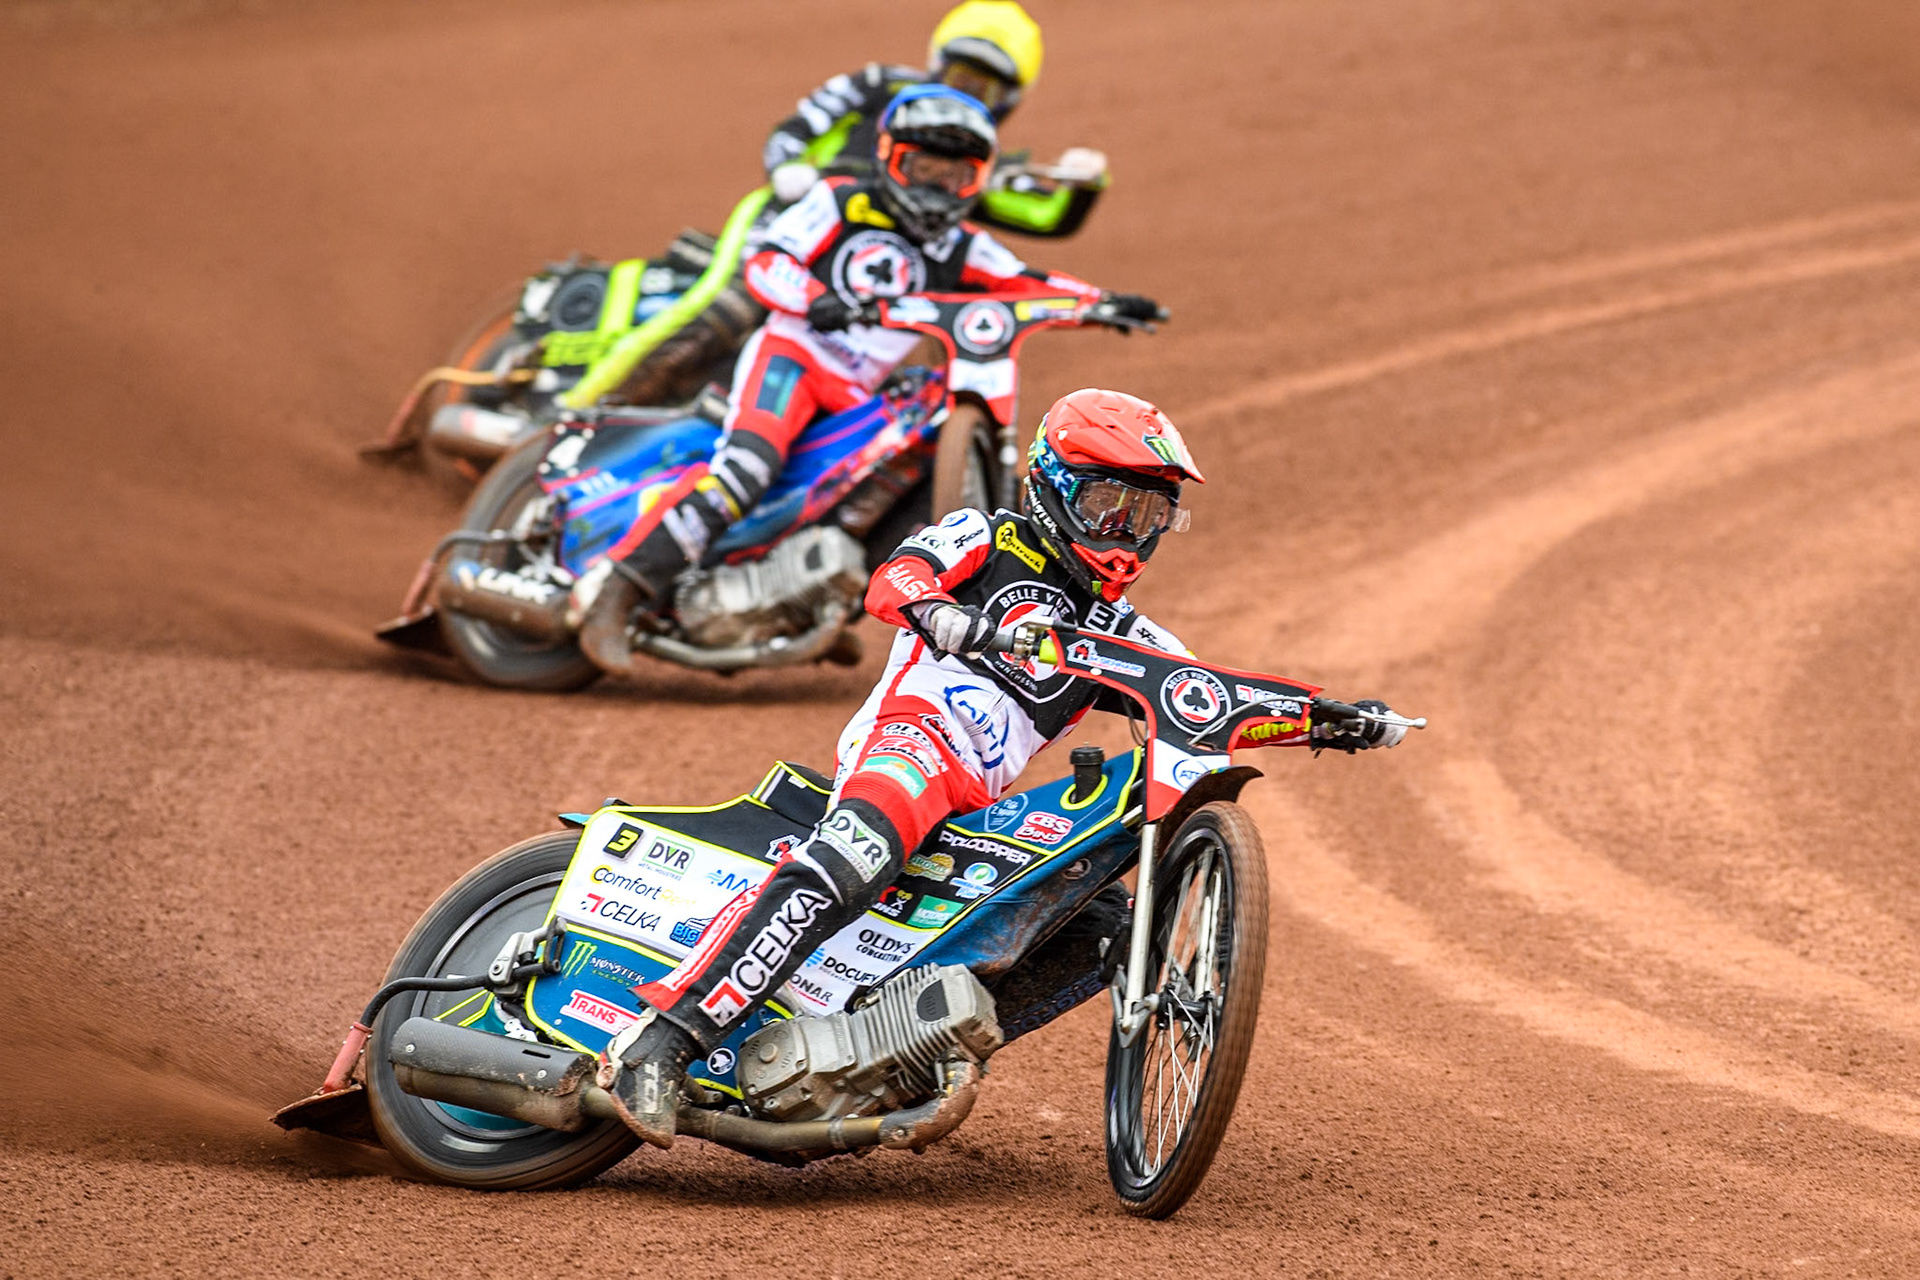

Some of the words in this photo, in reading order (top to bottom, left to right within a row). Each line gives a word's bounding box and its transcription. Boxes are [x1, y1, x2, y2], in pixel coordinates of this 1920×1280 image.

[998, 588, 1039, 609] BELLE
[1045, 592, 1070, 618] VUE
[1166, 672, 1190, 690] BELLE
[1190, 672, 1210, 682] VUE
[1017, 826, 1060, 841] BINS
[1027, 813, 1069, 834] CBS
[608, 829, 639, 853] 3
[829, 816, 883, 867] DVR
[648, 841, 690, 870] DVR
[592, 867, 662, 900] Comfort
[600, 900, 662, 932] CELKA
[673, 923, 699, 942] BIG
[735, 890, 831, 993] CELKA
[823, 956, 880, 984] DOCUFY
